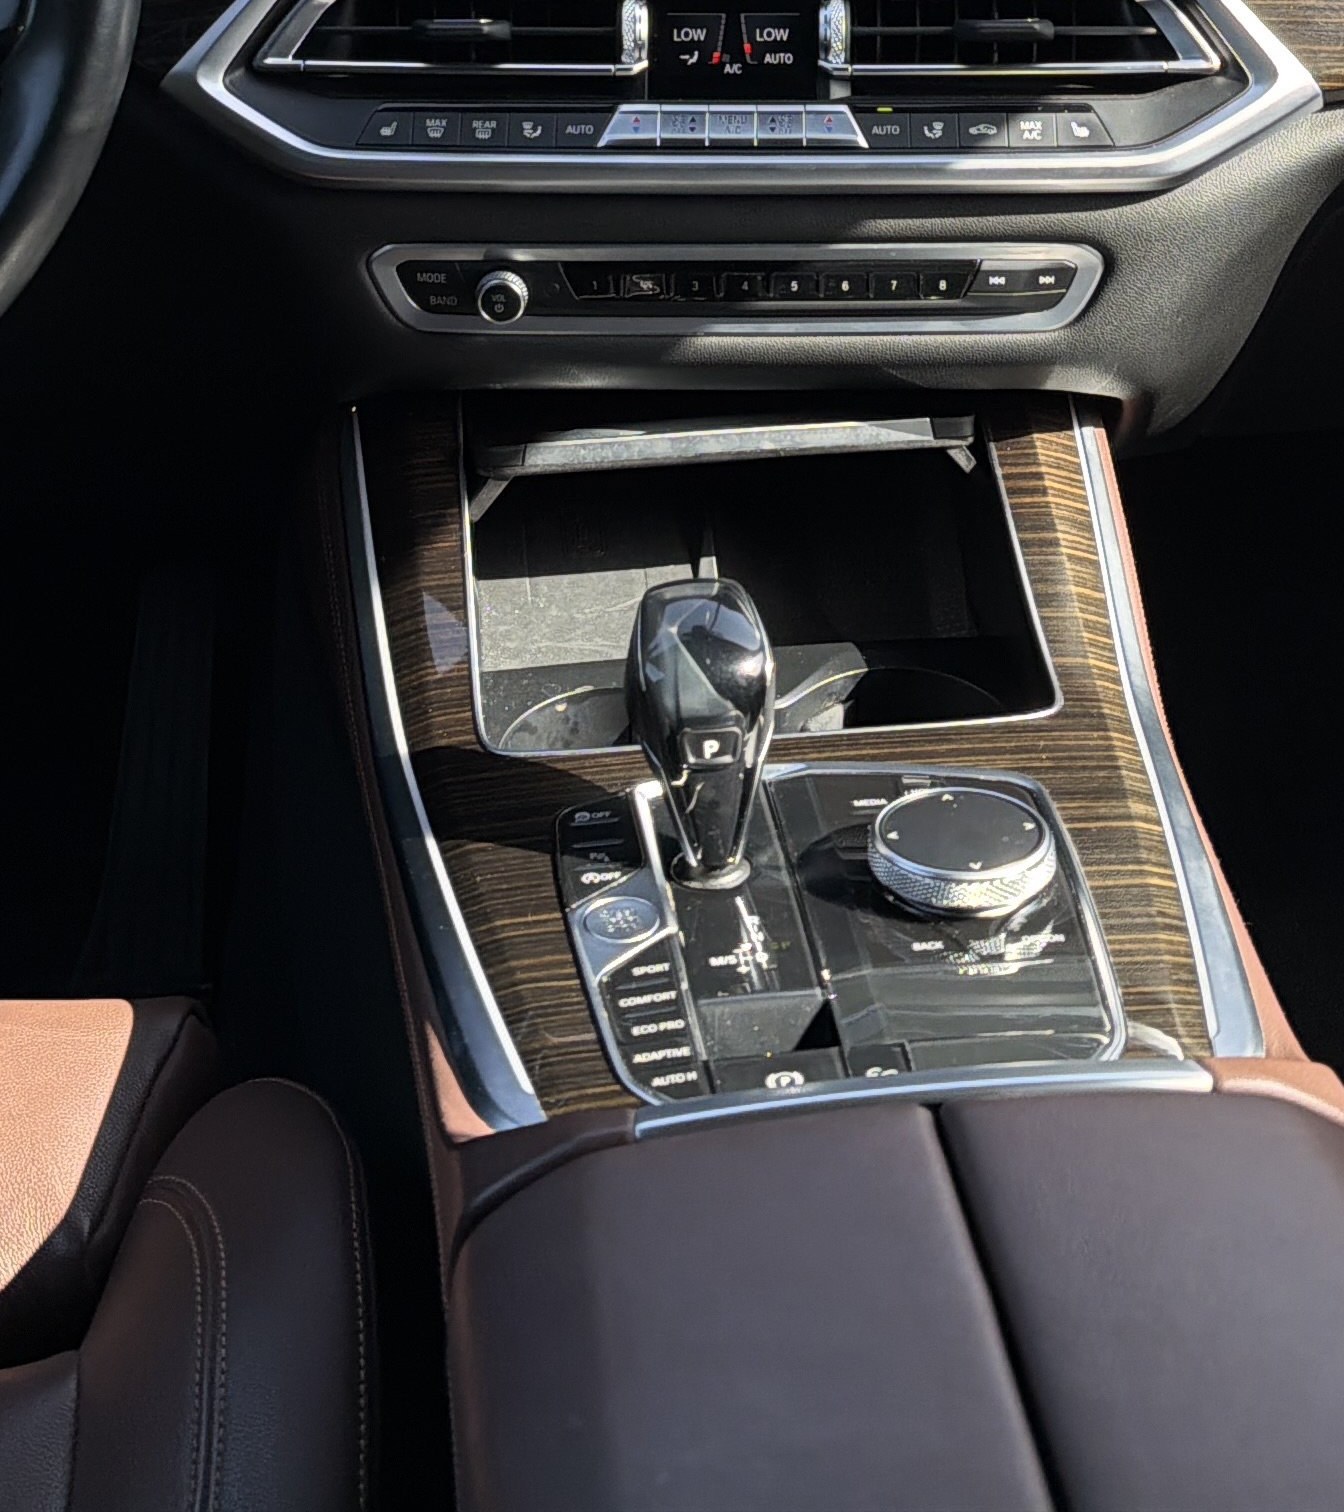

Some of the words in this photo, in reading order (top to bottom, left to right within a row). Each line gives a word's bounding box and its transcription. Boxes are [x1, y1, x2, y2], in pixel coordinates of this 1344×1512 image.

[673, 28, 707, 42] LOW
[756, 28, 789, 42] LOW
[763, 53, 794, 65] AUTO
[723, 63, 743, 75] A/C
[425, 118, 447, 128] MAX
[472, 120, 497, 129] REAR
[1020, 120, 1043, 131] MAX
[565, 124, 594, 135] AUTO
[872, 125, 900, 135] AUTO
[1022, 130, 1043, 140] A/C
[416, 272, 447, 284] MODE
[790, 280, 798, 291] 5
[841, 280, 850, 291] 6
[890, 280, 898, 291] 7
[939, 279, 947, 291] 8
[430, 295, 458, 306] BAND
[703, 739, 720, 760] P
[911, 941, 944, 951] BACK
[631, 962, 671, 977] SPORT
[618, 990, 677, 1008] COMFORT
[630, 1023, 657, 1037] ECO
[657, 1019, 685, 1033] PRO
[632, 1046, 691, 1064] ADAPTIVE
[651, 1073, 684, 1087] AUTO
